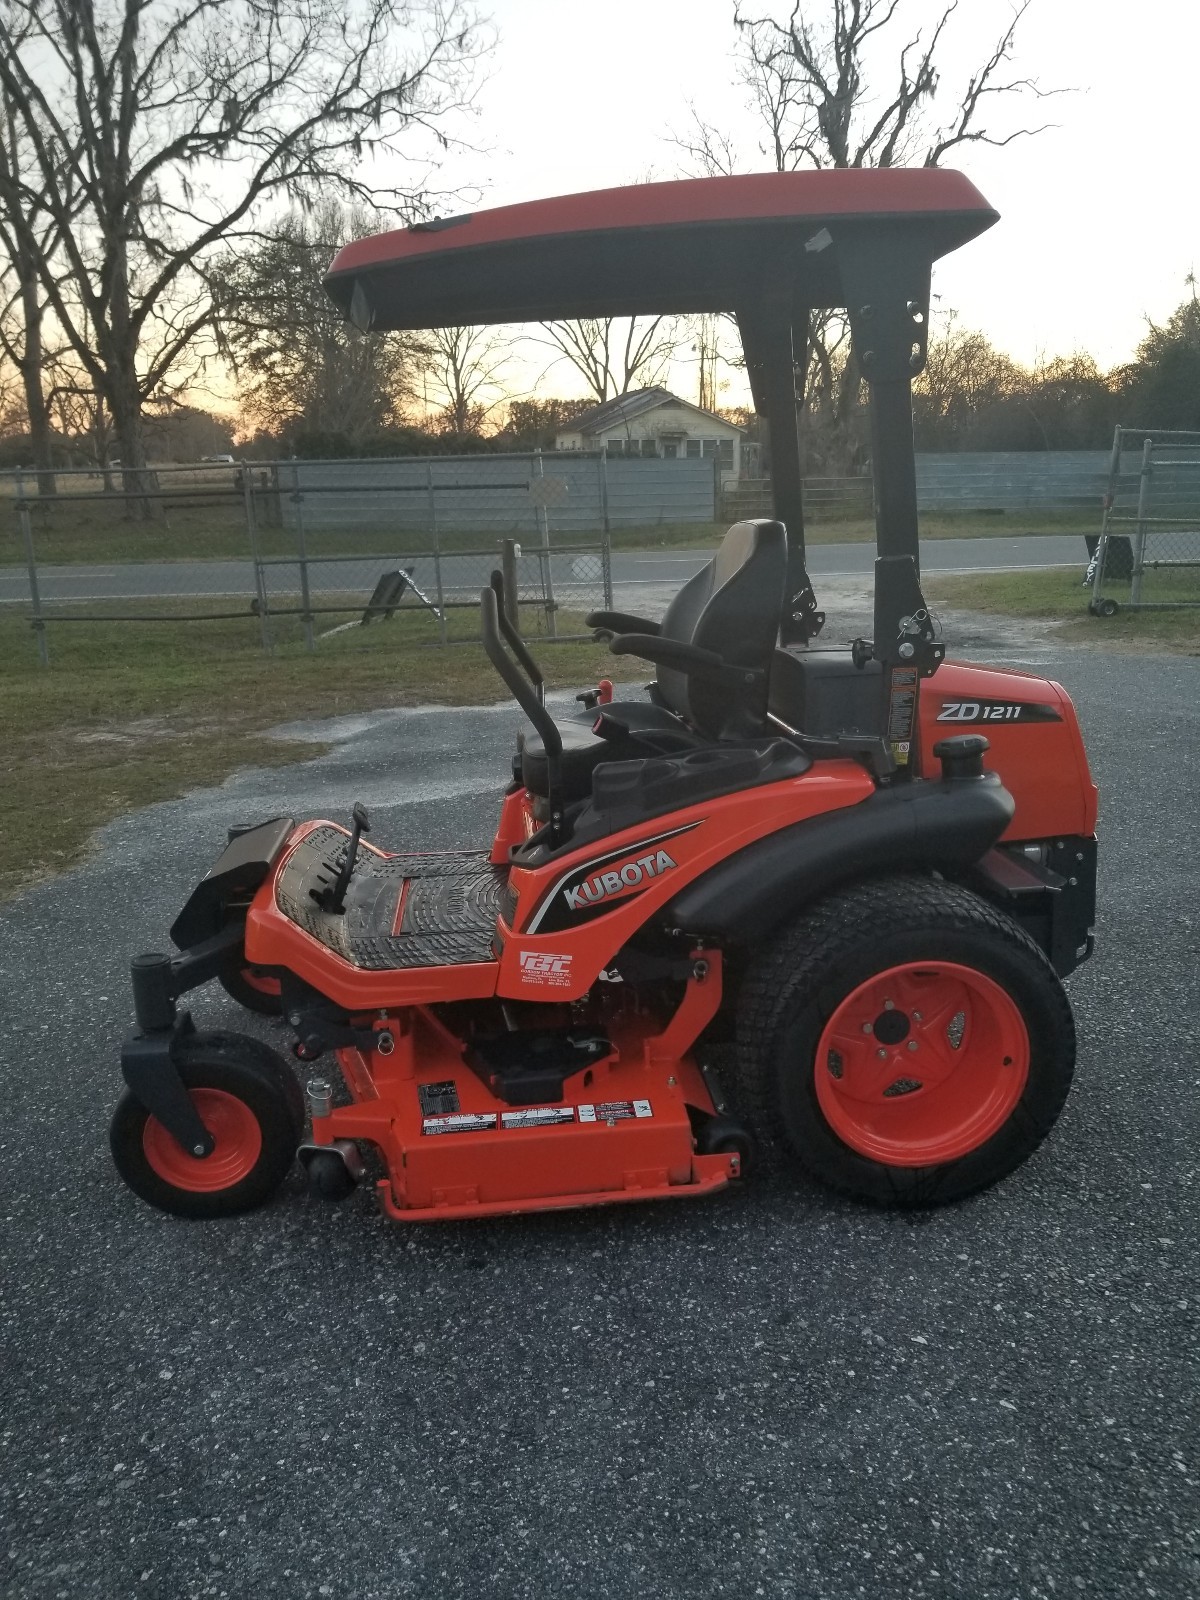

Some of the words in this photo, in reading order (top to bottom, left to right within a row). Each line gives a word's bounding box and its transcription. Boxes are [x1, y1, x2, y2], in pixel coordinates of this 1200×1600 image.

[936, 703, 980, 721] ZD
[982, 706, 1022, 719] 1211
[563, 850, 678, 910] KUBOTA
